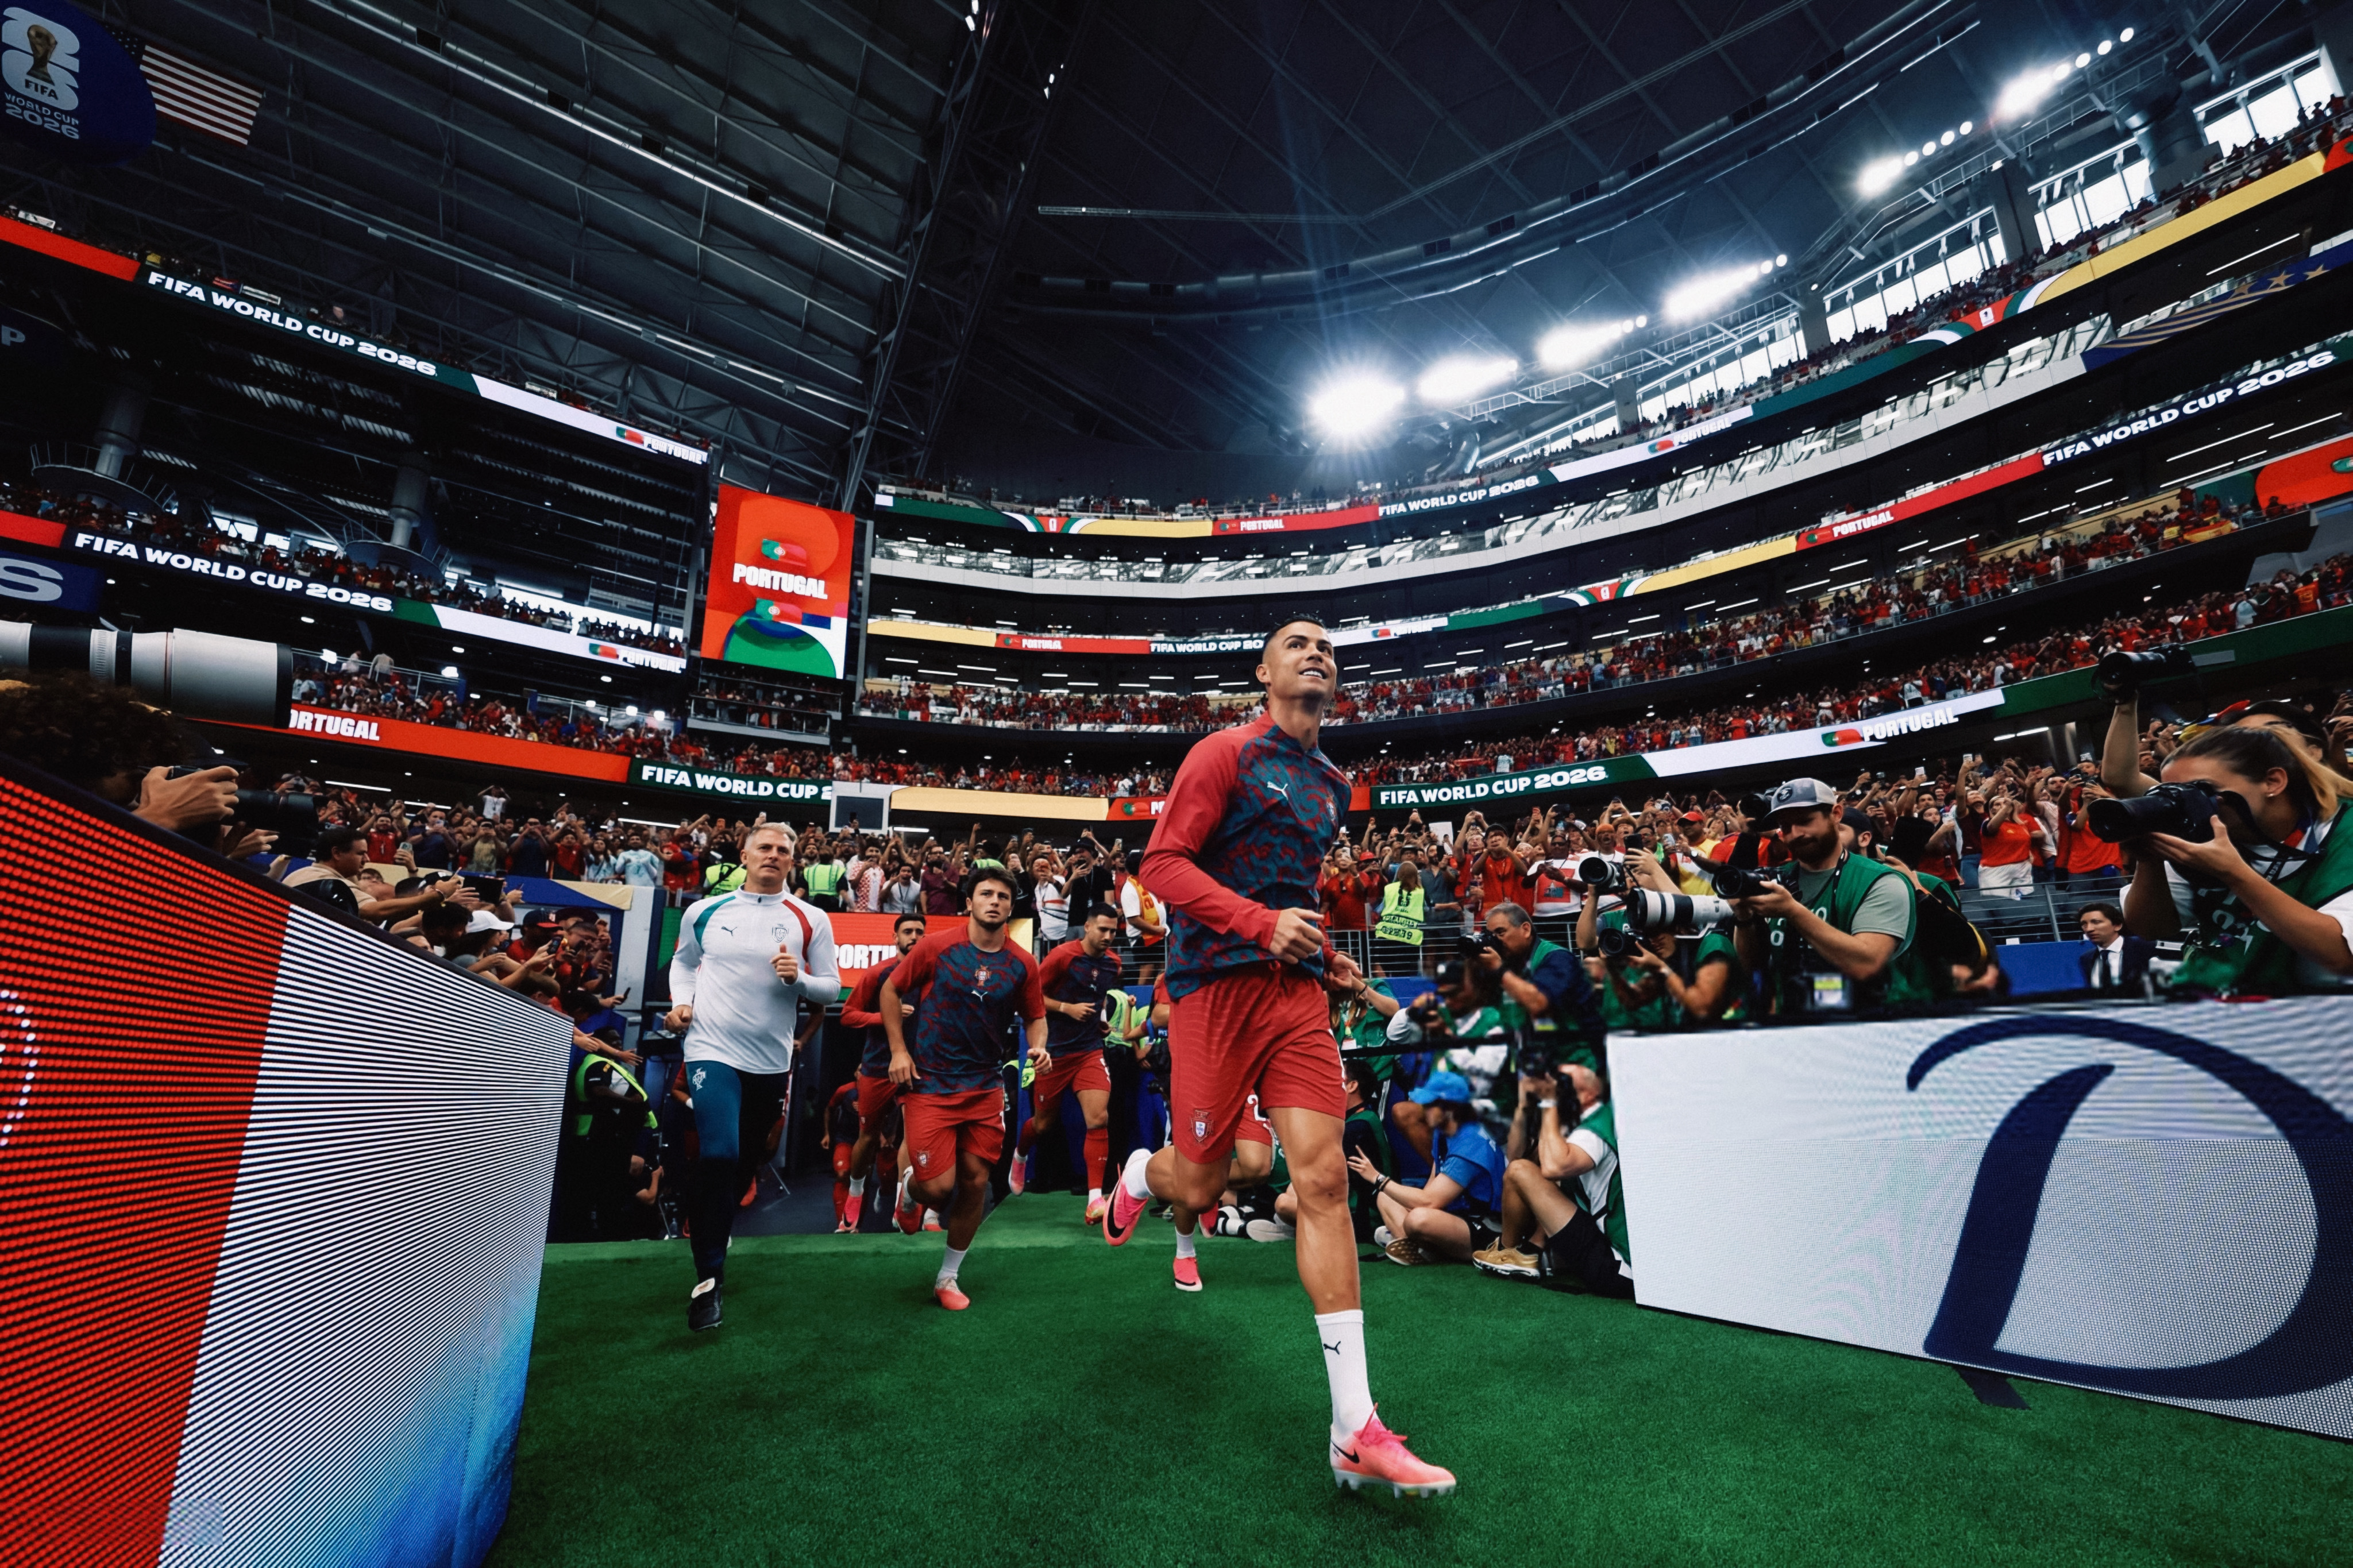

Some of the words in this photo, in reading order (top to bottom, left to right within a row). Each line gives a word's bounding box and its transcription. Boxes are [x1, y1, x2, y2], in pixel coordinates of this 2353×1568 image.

[5, 92, 51, 115] WORLD
[25, 79, 59, 101] FIFA
[5, 102, 79, 140] 2026
[1, 325, 26, 346] P
[148, 271, 206, 302] FIFA
[211, 291, 303, 332] WORLD
[307, 325, 355, 347] CUP
[357, 341, 436, 376] 2026
[2043, 441, 2091, 466] FIFA
[2091, 408, 2180, 447] WORLD
[2182, 388, 2234, 415] CUP
[2236, 350, 2335, 396] 2026
[1379, 503, 1407, 516] FIFA
[1407, 495, 1457, 511] WORLD
[1459, 489, 1487, 503] CUP
[1832, 510, 1894, 538] PORTUGAL
[0, 557, 64, 601] S
[75, 532, 138, 559] FIFA
[145, 547, 246, 581] WORLD
[250, 572, 303, 592] CUP
[305, 582, 392, 612] 2026
[733, 562, 828, 600] PORTUGAL
[1862, 706, 1959, 742] PORTUGAL
[642, 764, 691, 787] FIFA
[695, 773, 773, 796] WORLD
[776, 783, 818, 799] CUP
[1380, 790, 1418, 805] FIFA
[1421, 783, 1489, 803] WORLD
[1492, 777, 1531, 795] CUP
[1534, 766, 1607, 790] 2026
